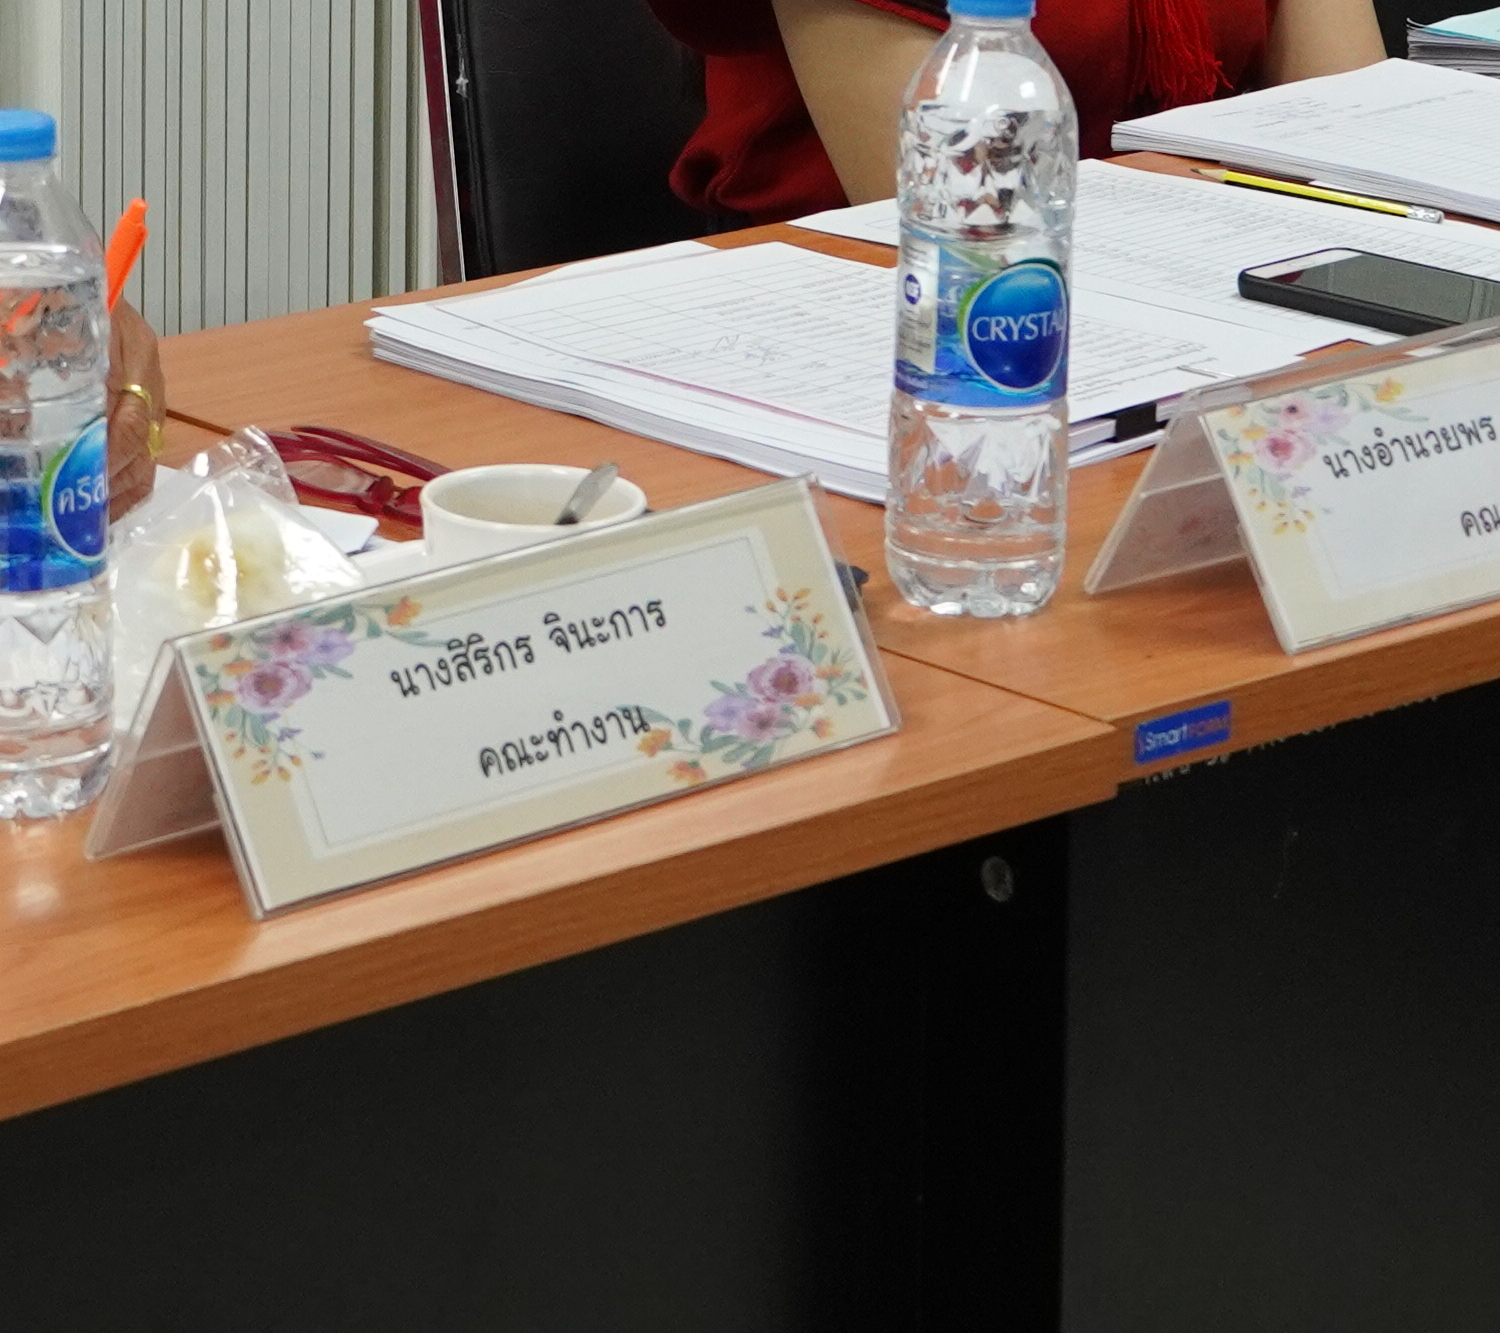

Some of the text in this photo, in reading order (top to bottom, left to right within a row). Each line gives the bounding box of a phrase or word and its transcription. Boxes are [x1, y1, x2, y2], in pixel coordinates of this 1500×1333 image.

[1323, 412, 1498, 479] นางอำนวยพร
[390, 597, 668, 700] นางสิริกร จินะการ
[478, 705, 650, 780] คณะทำงาน
